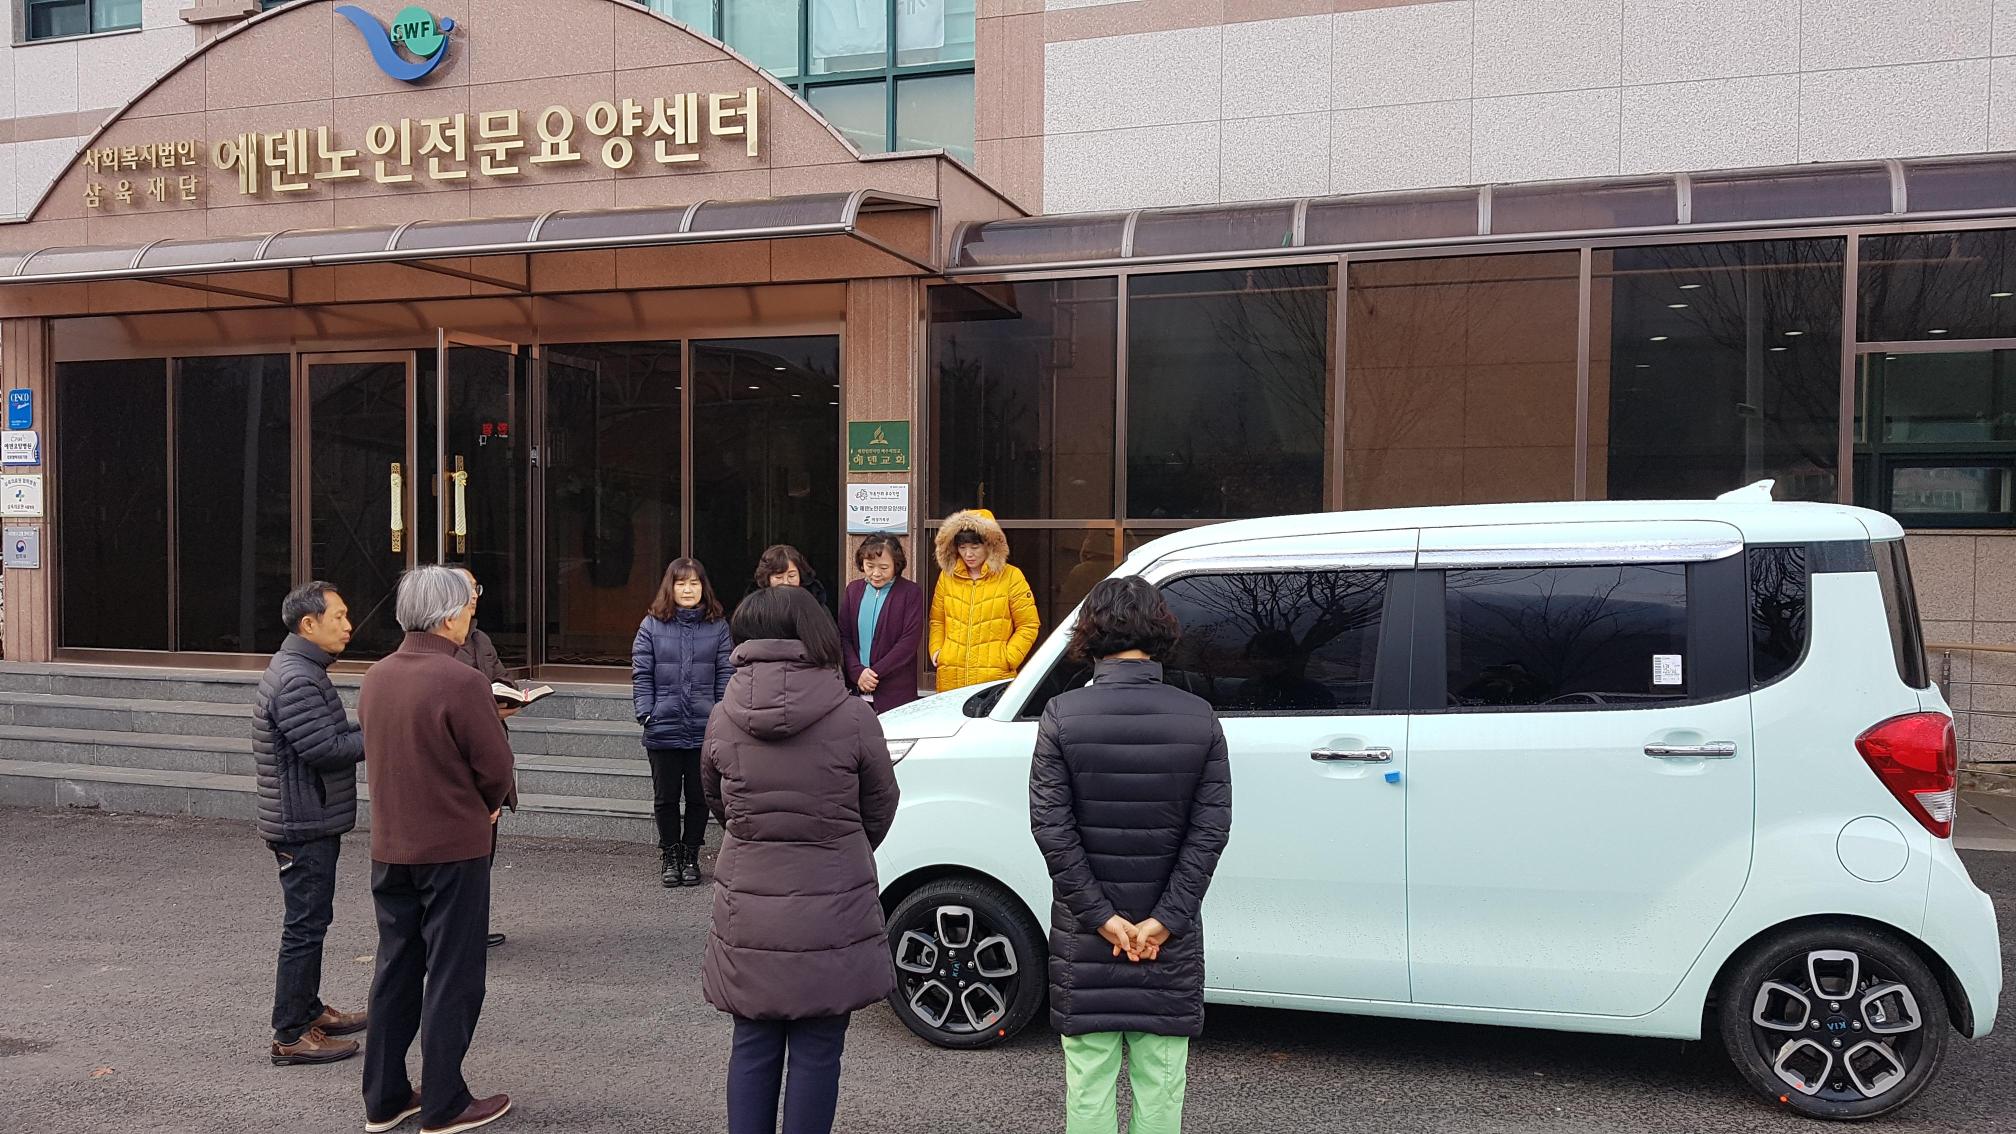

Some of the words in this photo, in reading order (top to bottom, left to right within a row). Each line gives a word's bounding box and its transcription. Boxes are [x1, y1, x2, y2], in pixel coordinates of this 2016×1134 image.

[393, 21, 430, 41] SWF
[213, 86, 760, 195] 에덴노인전문요양센터
[83, 139, 196, 173] 사회복지법인
[1826, 1021, 1847, 1030] KIA
